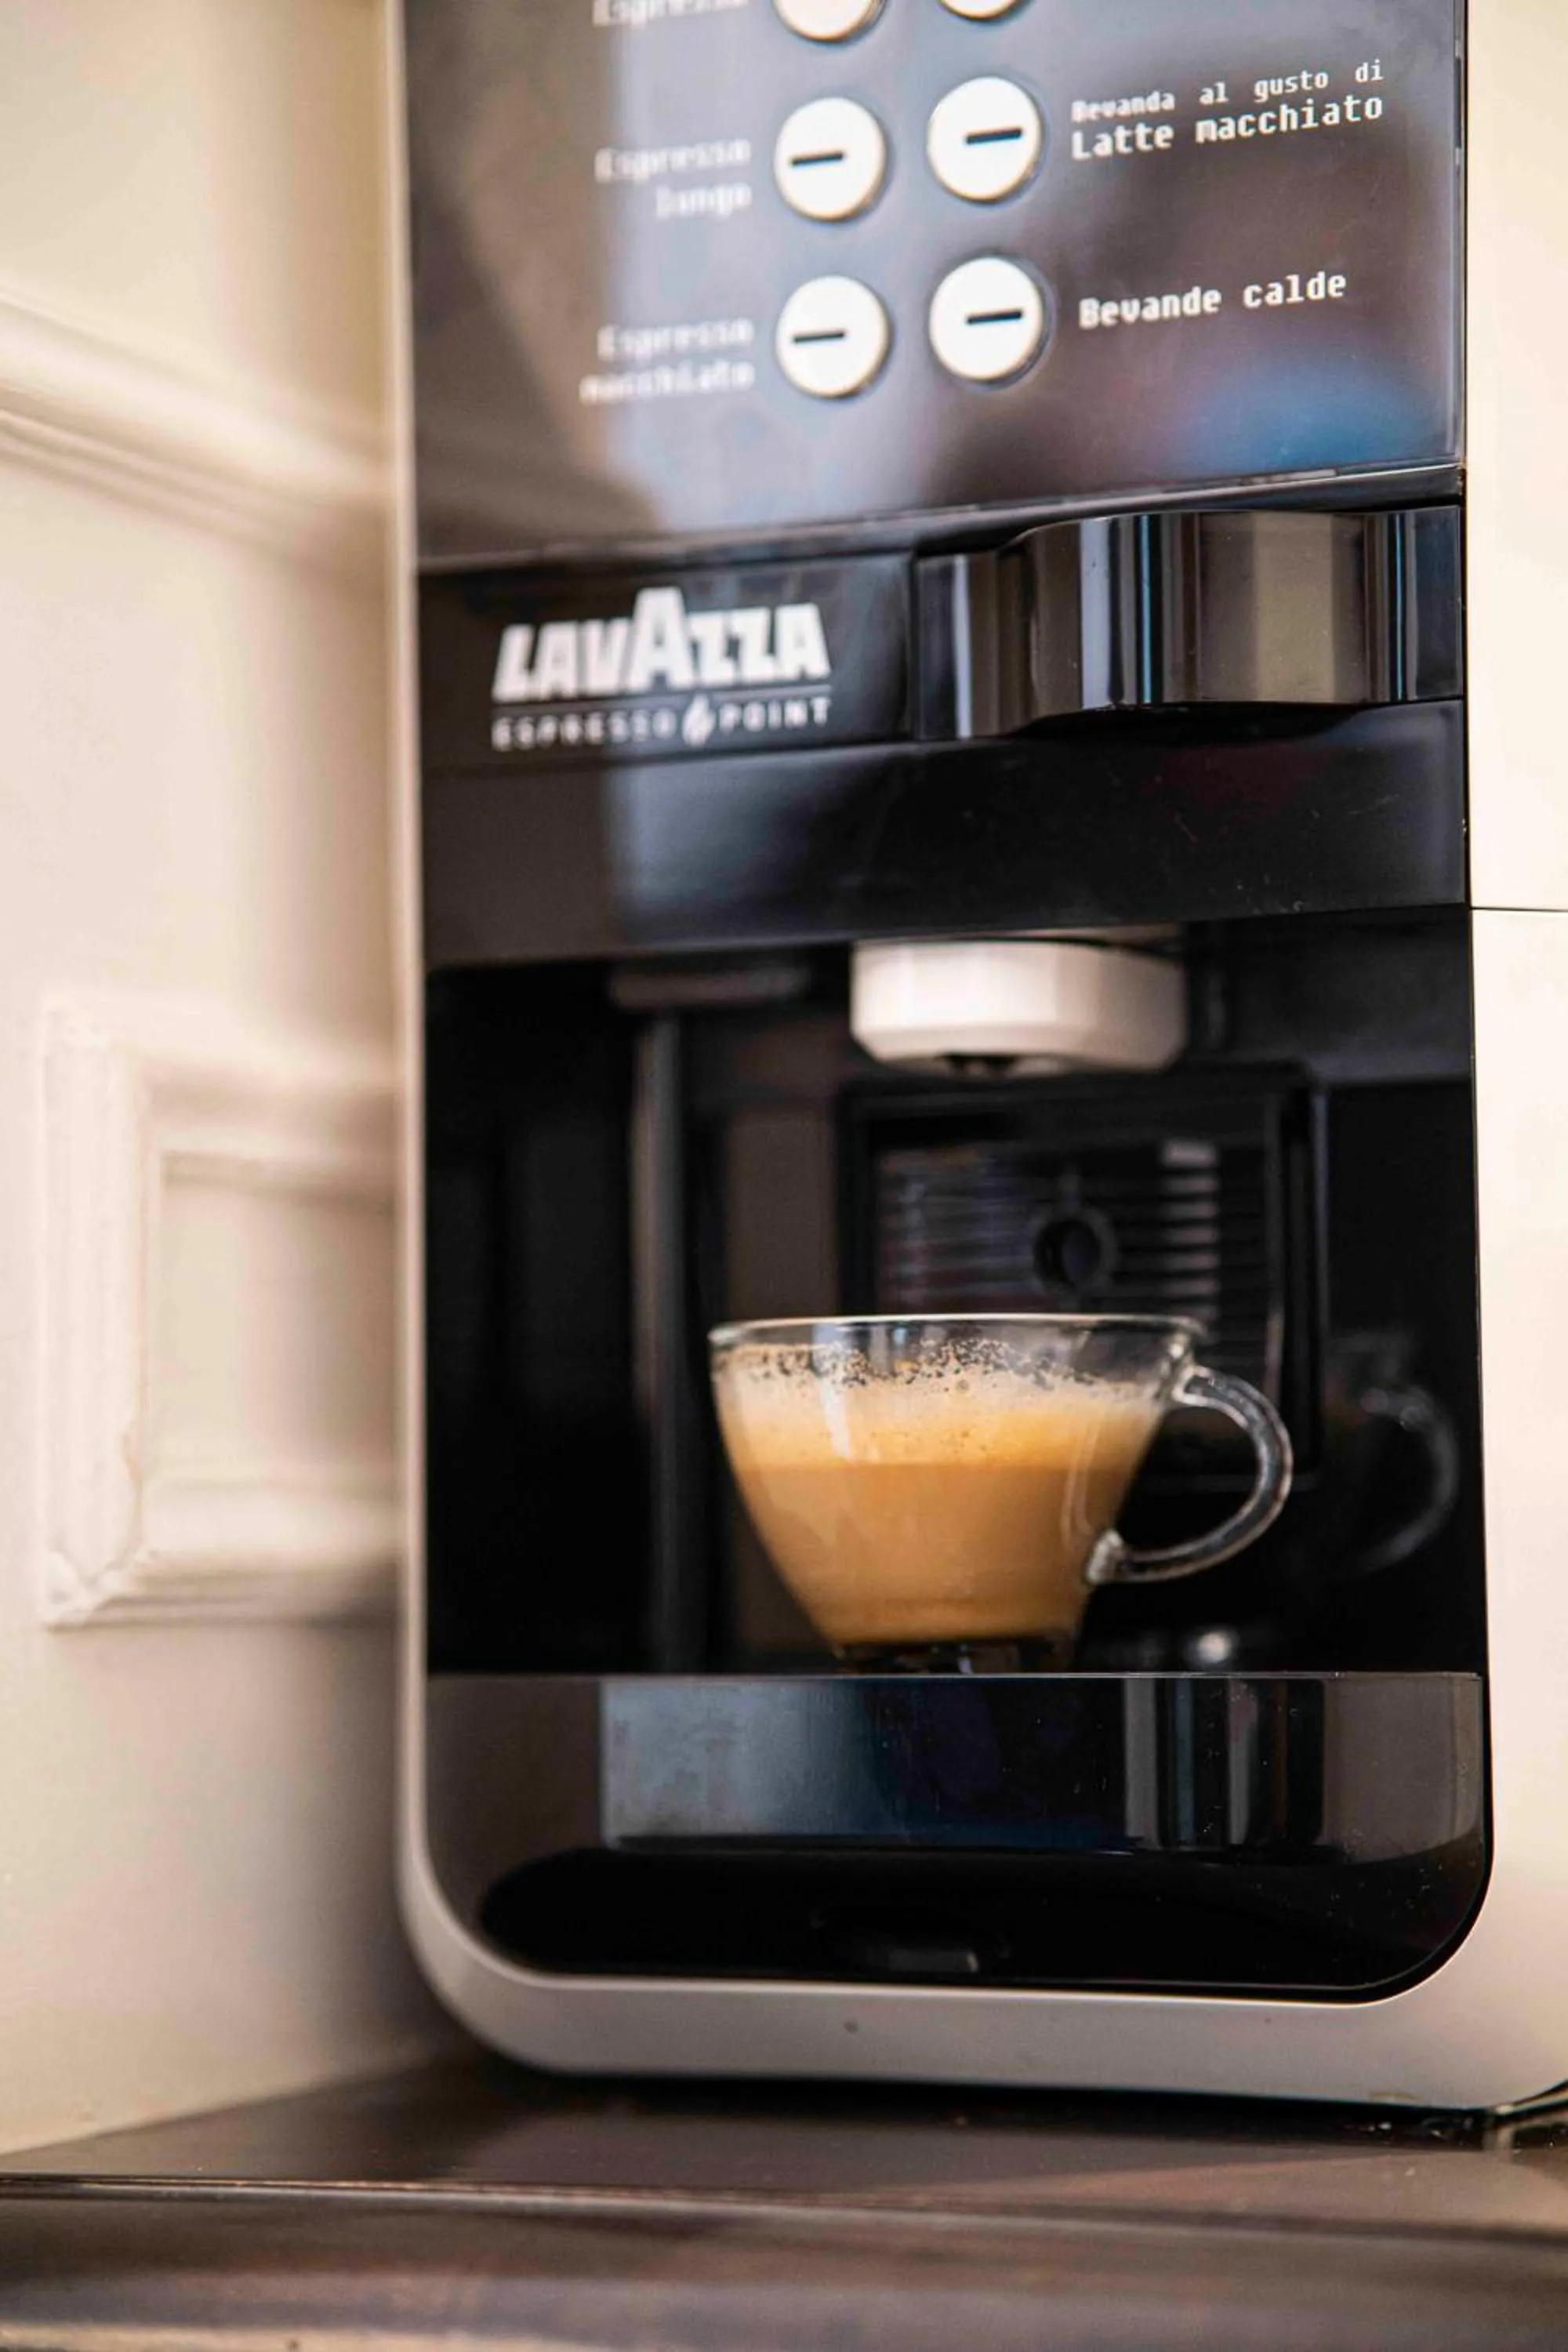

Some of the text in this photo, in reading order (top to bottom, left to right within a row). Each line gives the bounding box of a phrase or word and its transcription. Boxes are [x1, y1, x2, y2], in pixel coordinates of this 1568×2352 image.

[1071, 59, 1384, 123] Bevanda al gusto di
[1071, 93, 1383, 162] Latte macchiato
[1078, 271, 1347, 329] Bevande calde
[492, 586, 831, 702] LAVAZZA
[492, 697, 831, 752] ESPRESSO POINT
